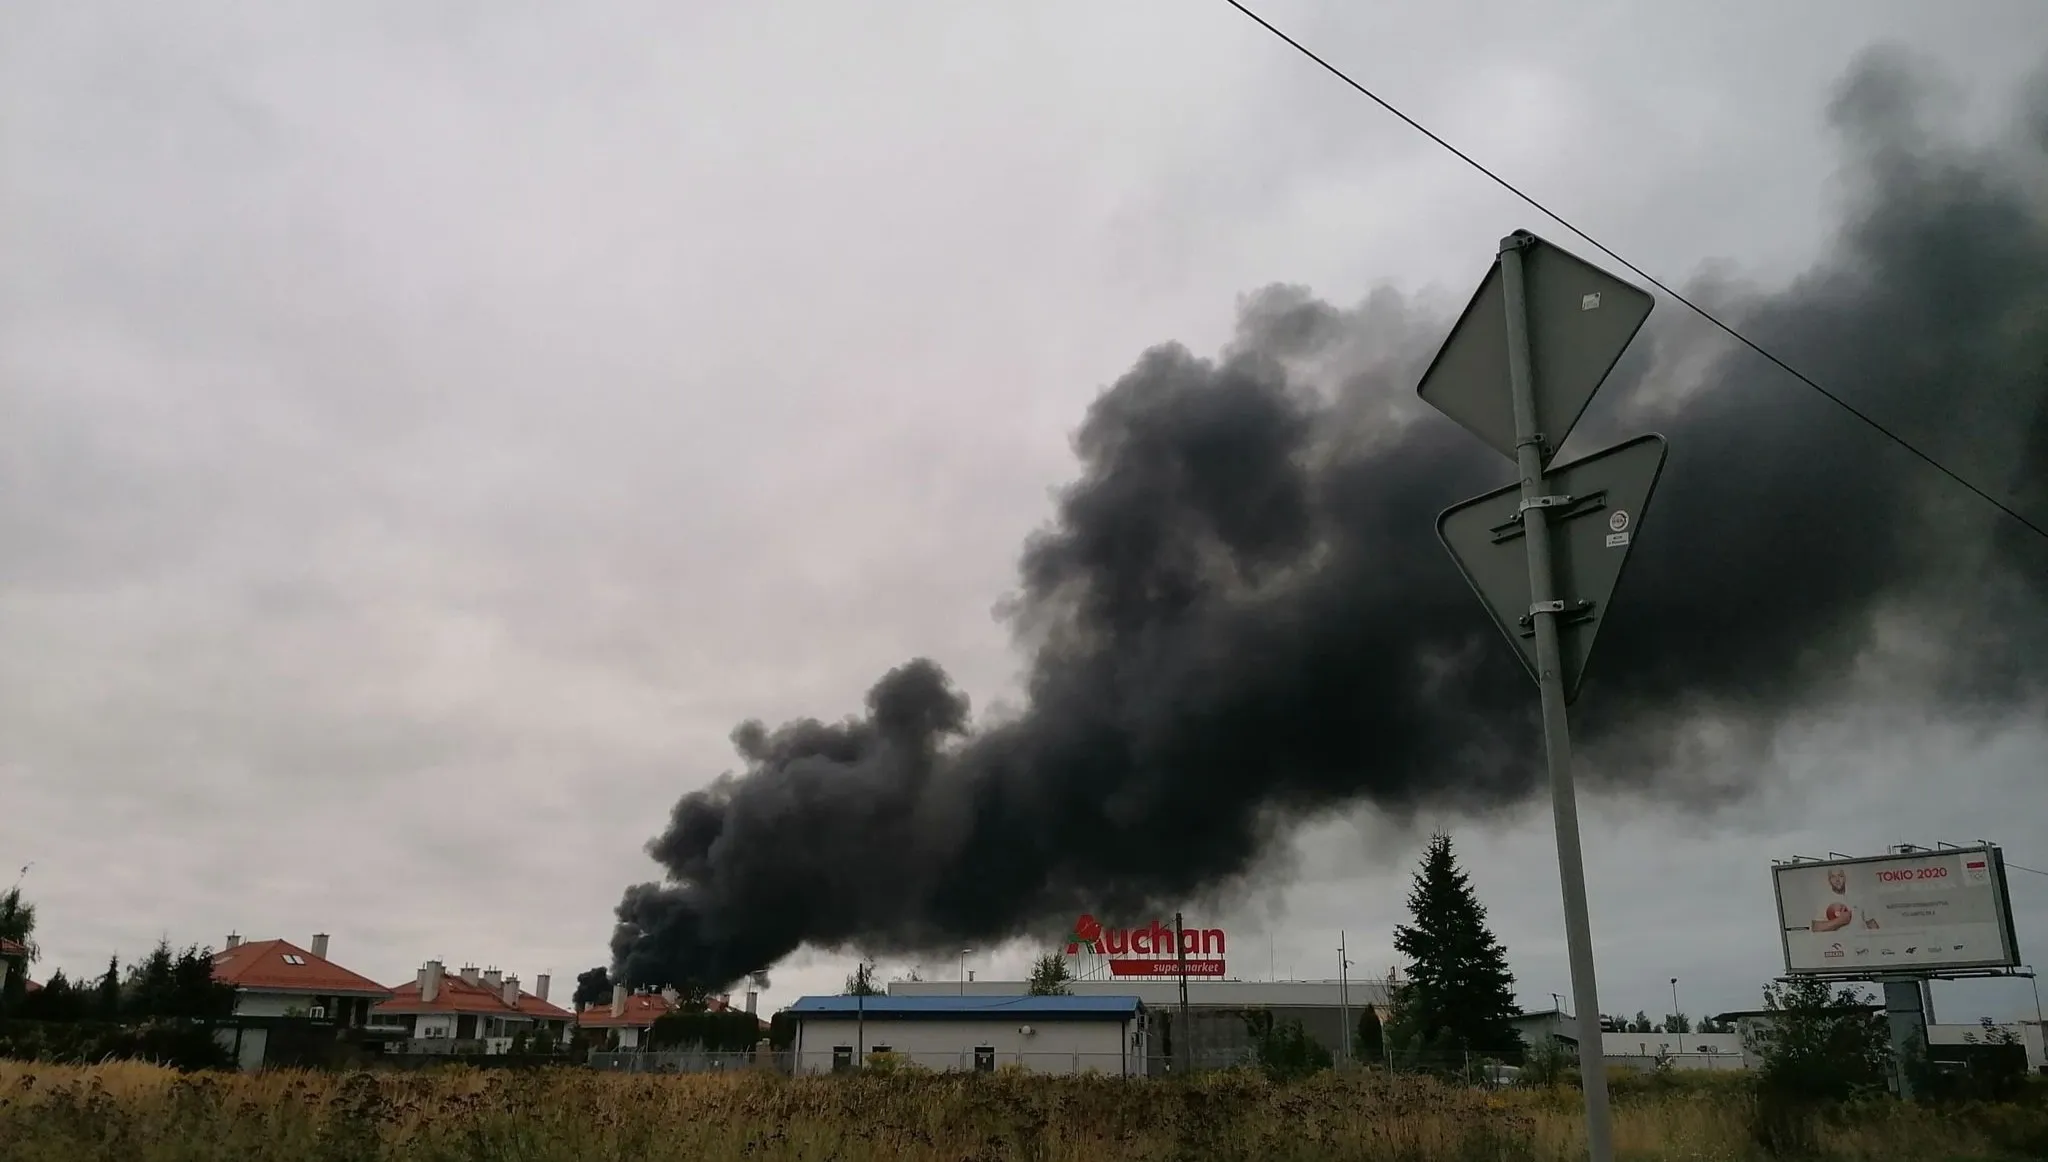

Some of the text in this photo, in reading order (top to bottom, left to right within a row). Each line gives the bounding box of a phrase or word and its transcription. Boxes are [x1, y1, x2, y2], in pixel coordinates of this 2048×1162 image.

[1876, 867, 1947, 882] TOKIO 2020
[1067, 914, 1225, 954] Auchan
